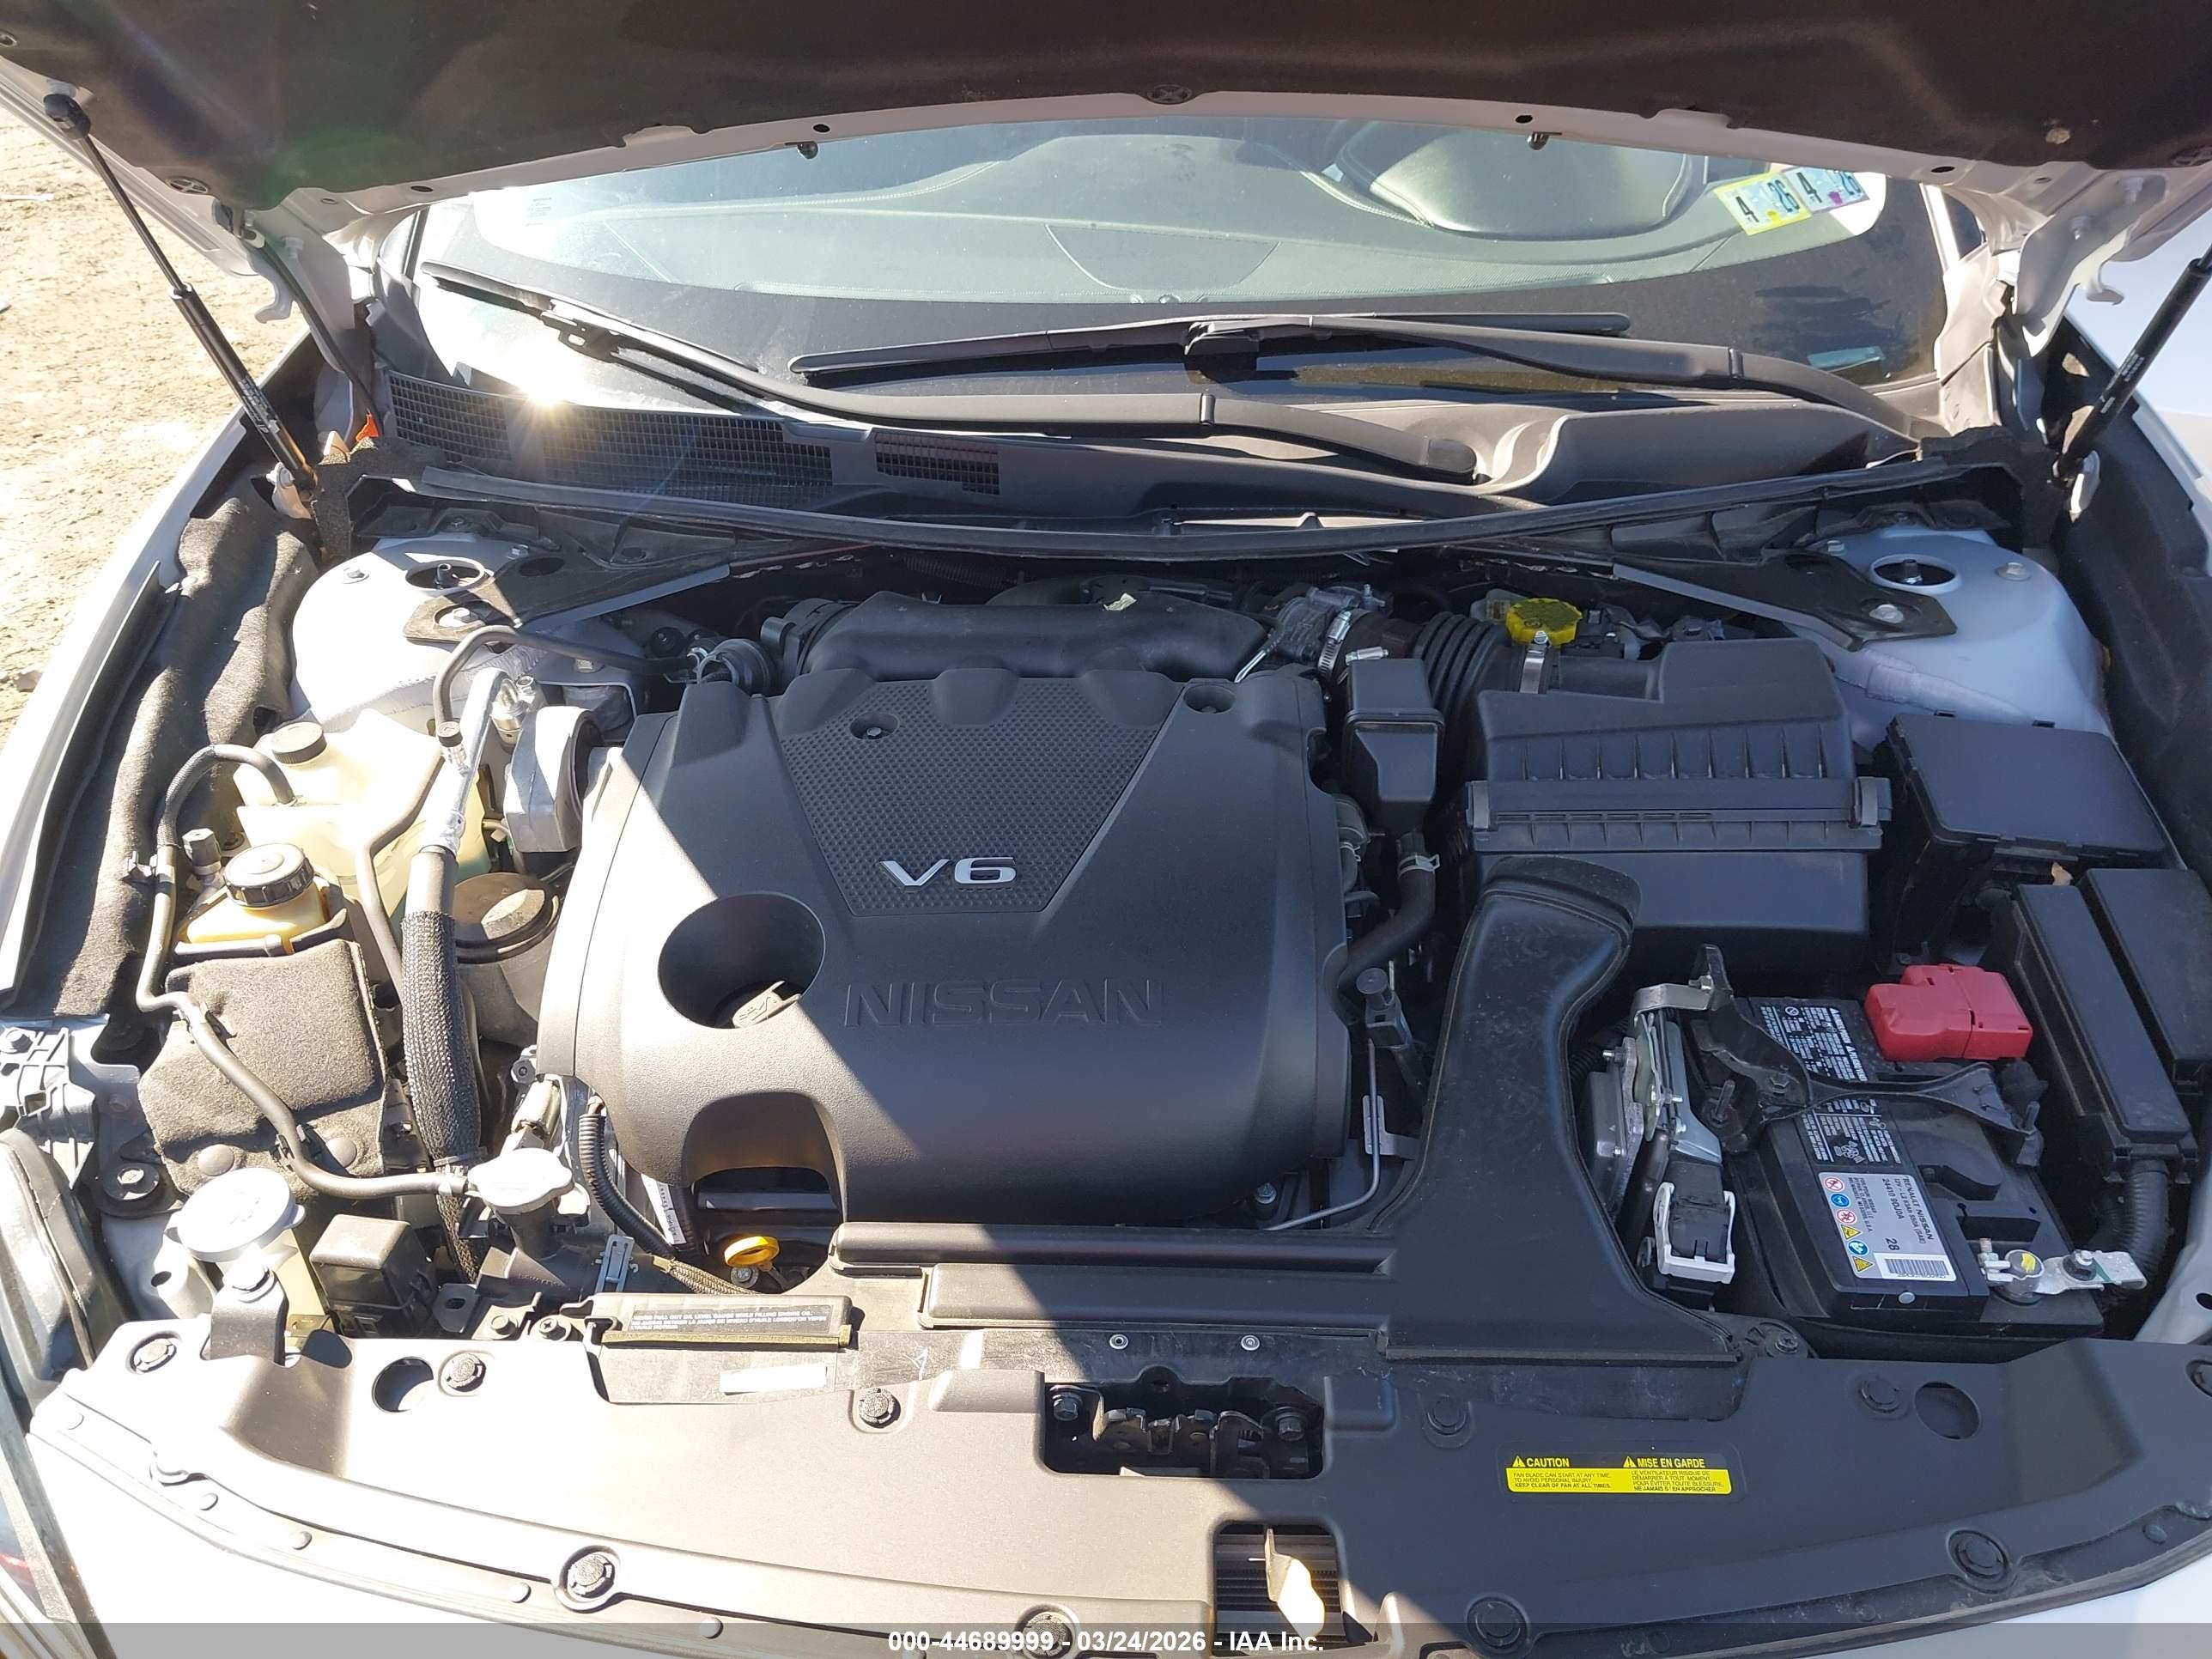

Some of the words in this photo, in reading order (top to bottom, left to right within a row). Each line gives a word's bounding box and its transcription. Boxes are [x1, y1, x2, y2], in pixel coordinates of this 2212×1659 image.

[1735, 196, 1759, 222] 4
[879, 857, 1018, 890] V6
[844, 978, 1162, 1027] NISSAN
[1881, 1178, 1895, 1196] 24410
[1902, 1178, 1920, 1206] RENAULT
[1915, 1209, 1935, 1239] NISSAN
[1885, 1237, 1899, 1250] 28
[1527, 1458, 1570, 1467] CAUTION
[1638, 1458, 1659, 1468] MISE
[1661, 1458, 1673, 1468] EN
[1674, 1458, 1705, 1468] GARDE
